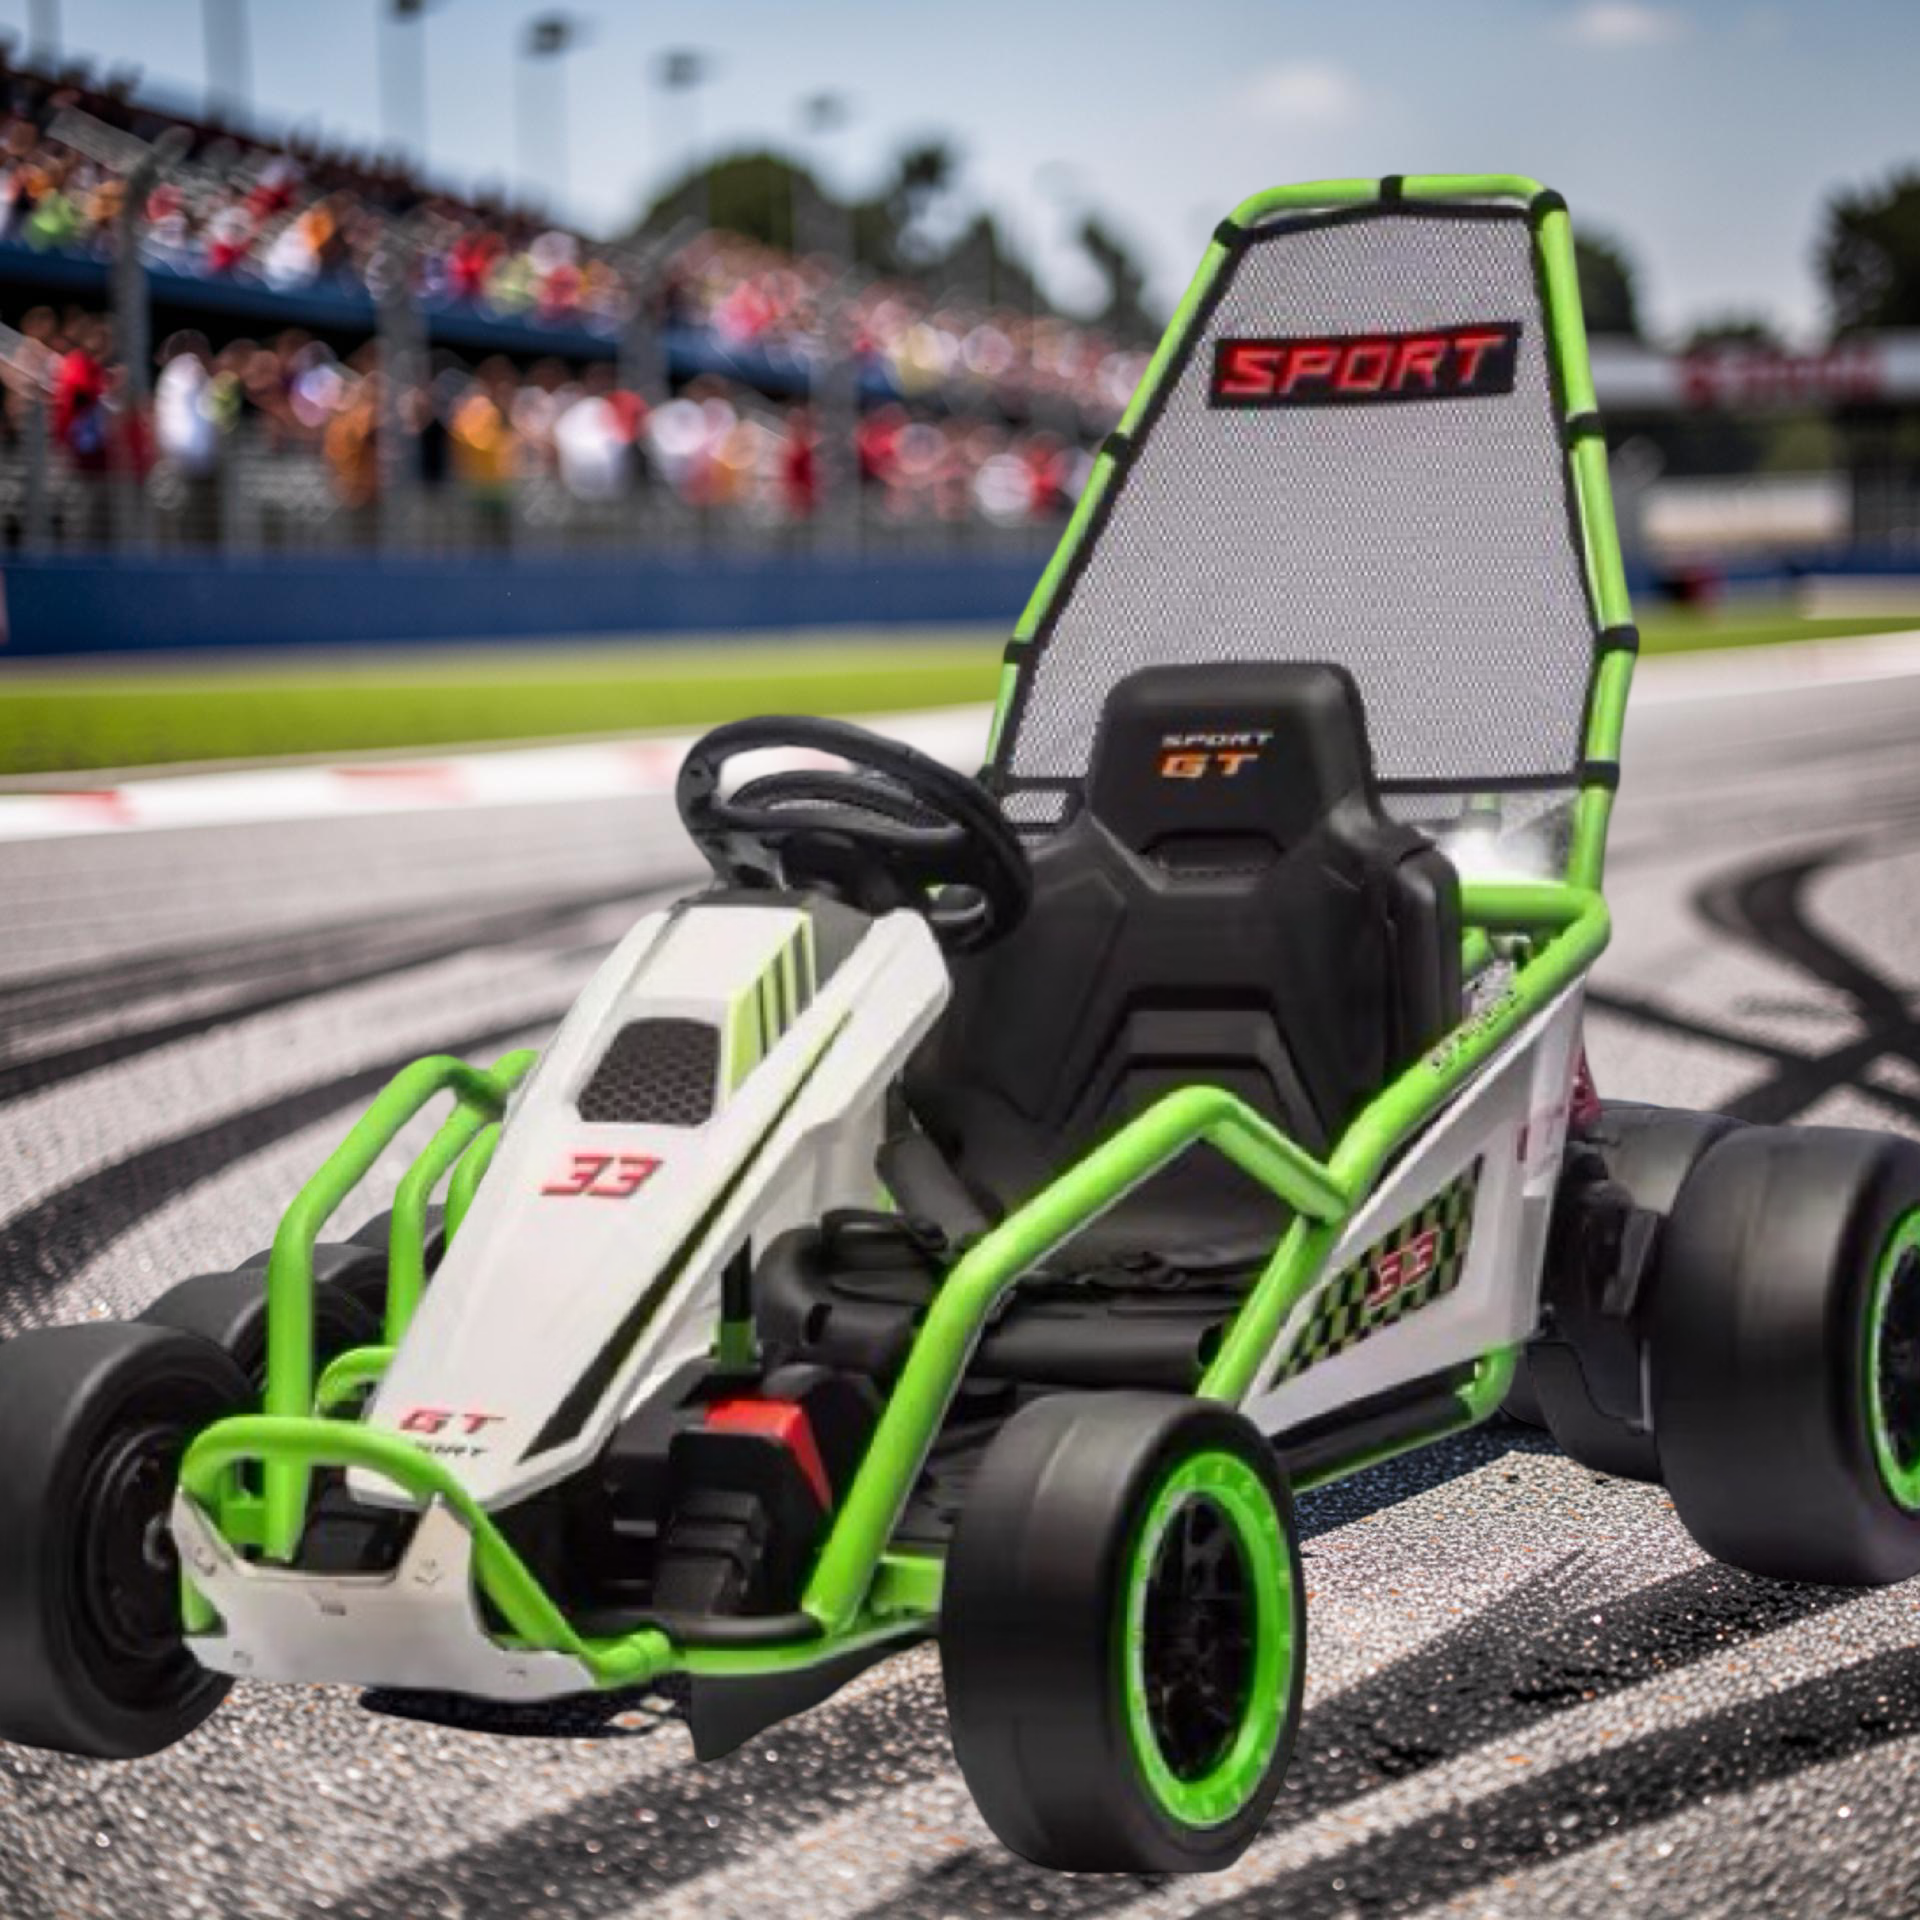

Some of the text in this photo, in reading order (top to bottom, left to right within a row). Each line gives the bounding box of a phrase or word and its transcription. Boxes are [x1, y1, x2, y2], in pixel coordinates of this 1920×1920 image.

[1219, 333, 1507, 395] SPORT
[1160, 731, 1275, 747] SPORT
[1160, 752, 1258, 778] GT
[540, 1153, 663, 1199] 33
[1367, 1229, 1436, 1307] 33
[400, 1409, 506, 1434] GT
